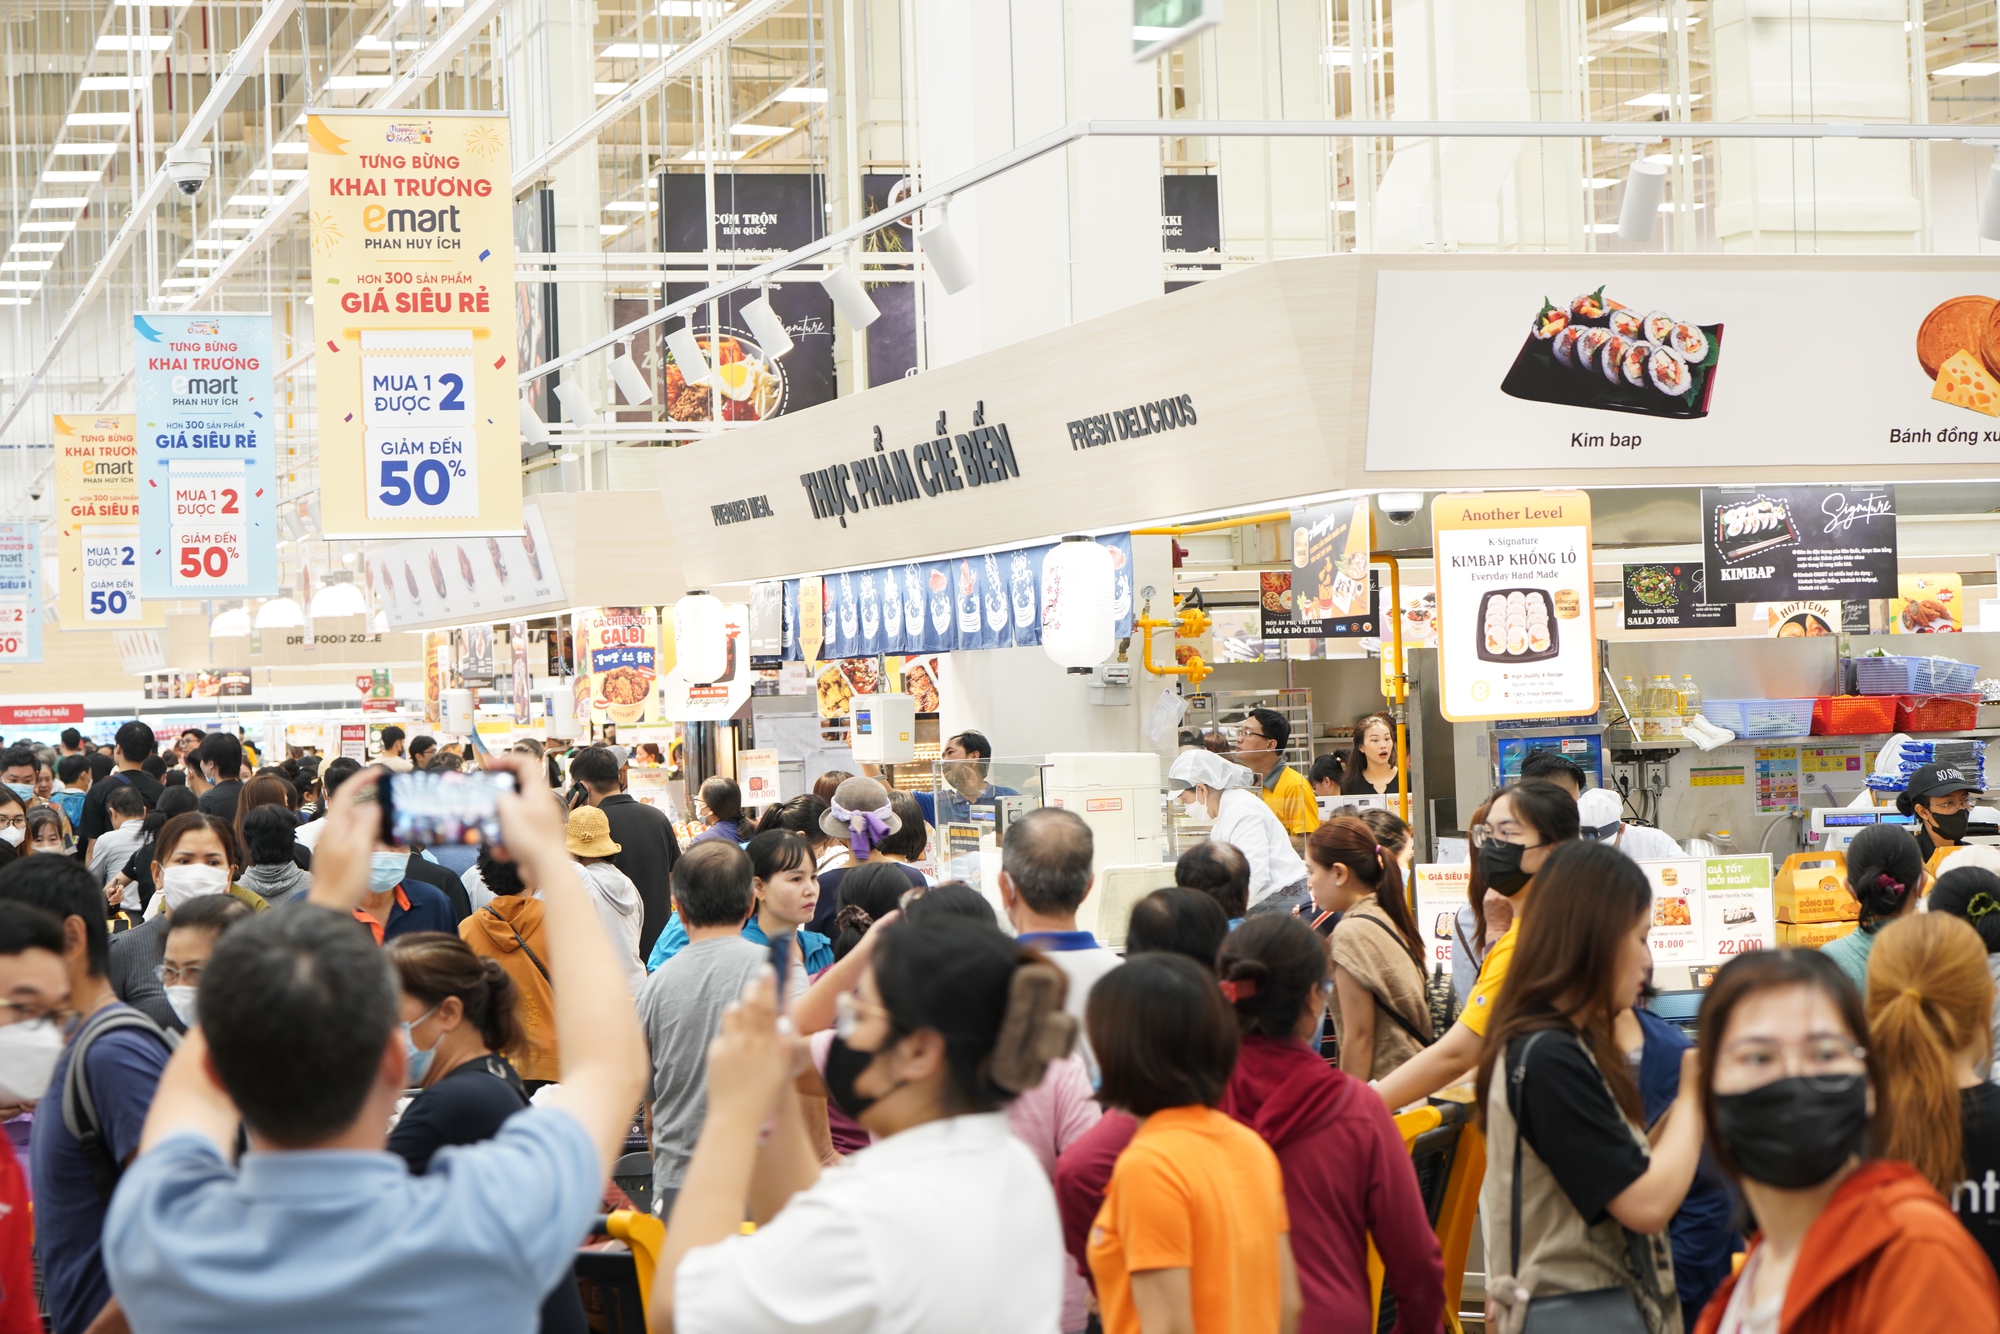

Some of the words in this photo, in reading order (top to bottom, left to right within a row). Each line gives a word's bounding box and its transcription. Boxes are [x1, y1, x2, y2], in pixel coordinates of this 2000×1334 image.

[360, 154, 406, 169] TƯNG
[412, 152, 460, 169] BỪNG
[330, 178, 386, 196] KHAI
[394, 176, 492, 198] TRƯƠNG
[363, 204, 460, 233] emart
[714, 213, 740, 225] CƠM
[742, 212, 778, 226] TRỘN
[743, 225, 766, 236] QUỐC
[364, 239, 402, 249] PHAN
[406, 239, 432, 249] HUY
[437, 236, 460, 249] ÍCH
[358, 274, 382, 284] HƠN
[384, 272, 412, 284] 300
[416, 272, 438, 284] SẢN
[442, 271, 472, 284] PHẨM
[341, 286, 390, 314] GIÁ
[396, 286, 452, 314] SIÊU
[459, 286, 490, 312] RẺ
[782, 315, 829, 342] ignature
[169, 342, 201, 352] TƯNG
[204, 340, 238, 352] BỪNG
[148, 358, 187, 370] KHAI
[193, 357, 260, 370] TRƯƠNG
[171, 374, 238, 394] emart
[373, 376, 418, 391] MUA
[424, 375, 432, 391] 1
[222, 396, 238, 406] ÍCH
[374, 396, 430, 416] ĐƯỢC
[438, 373, 465, 410] 2
[185, 421, 204, 429] 300
[1066, 412, 1116, 450] FRESH
[1113, 393, 1196, 440] DELICIOUS
[108, 434, 133, 442] BỪNG
[156, 431, 188, 448] GIÁ
[192, 431, 230, 448] SIÊU
[235, 430, 257, 448] RẺ
[1571, 432, 1604, 447] Kim
[1610, 432, 1642, 450] bap
[1890, 428, 1932, 443] Bánh
[1937, 426, 1978, 445] đồng
[66, 447, 94, 456] KHAI
[99, 446, 138, 456] TRƯƠN
[381, 438, 424, 454] GIẢM
[430, 436, 462, 454] ĐẾN
[82, 460, 133, 475] emart
[800, 463, 859, 528] THỰC
[850, 424, 920, 509] PHẨM
[913, 410, 964, 498] CHẾ
[954, 400, 1020, 487] BIẾN
[379, 458, 466, 506] 50%
[176, 490, 207, 501] MUA
[211, 490, 216, 500] 1
[177, 504, 216, 517] ĐƯỢC
[220, 488, 239, 514] 2
[71, 503, 96, 516] GIÁ
[99, 502, 128, 516] SIÊU
[1462, 508, 1520, 521] Another
[1525, 506, 1563, 519] Level
[1822, 493, 1896, 533] Signature
[181, 532, 210, 543] GIẢM
[214, 531, 237, 543] ĐẾN
[1488, 537, 1539, 547] K-Signature
[121, 546, 135, 565] 2
[180, 546, 239, 578] 50%
[1452, 554, 1504, 567] KIMBAP
[1561, 546, 1576, 564] LỒ
[1471, 572, 1509, 582] Everyday
[1511, 571, 1533, 580] Hand
[1536, 570, 1558, 578] Made
[1720, 566, 1776, 581] KIMBAP
[91, 580, 114, 588] GIẢM
[90, 590, 136, 614] 50%
[1780, 601, 1830, 618] HOTTEOK
[593, 616, 604, 628] GÀ
[634, 611, 652, 625] SỐT
[1627, 617, 1654, 625] SALAD
[1657, 616, 1680, 624] ZONE
[314, 635, 346, 644] FOOD
[350, 634, 382, 643] ZOE
[601, 628, 645, 645] GALBI
[14, 706, 51, 718] KHUYẾN
[1936, 770, 1947, 781] SO
[749, 790, 776, 798] 99.000
[1428, 872, 1443, 880] GIÁ
[1445, 872, 1462, 880] SIÊU
[1707, 864, 1723, 874] GIÁ
[1725, 863, 1742, 873] TỐT
[1708, 875, 1725, 885] MỖI
[1727, 875, 1751, 885] NGÀY
[1799, 897, 1822, 908] ĐỒNG
[1654, 940, 1684, 949] 78.000
[1718, 939, 1762, 954] 22.000
